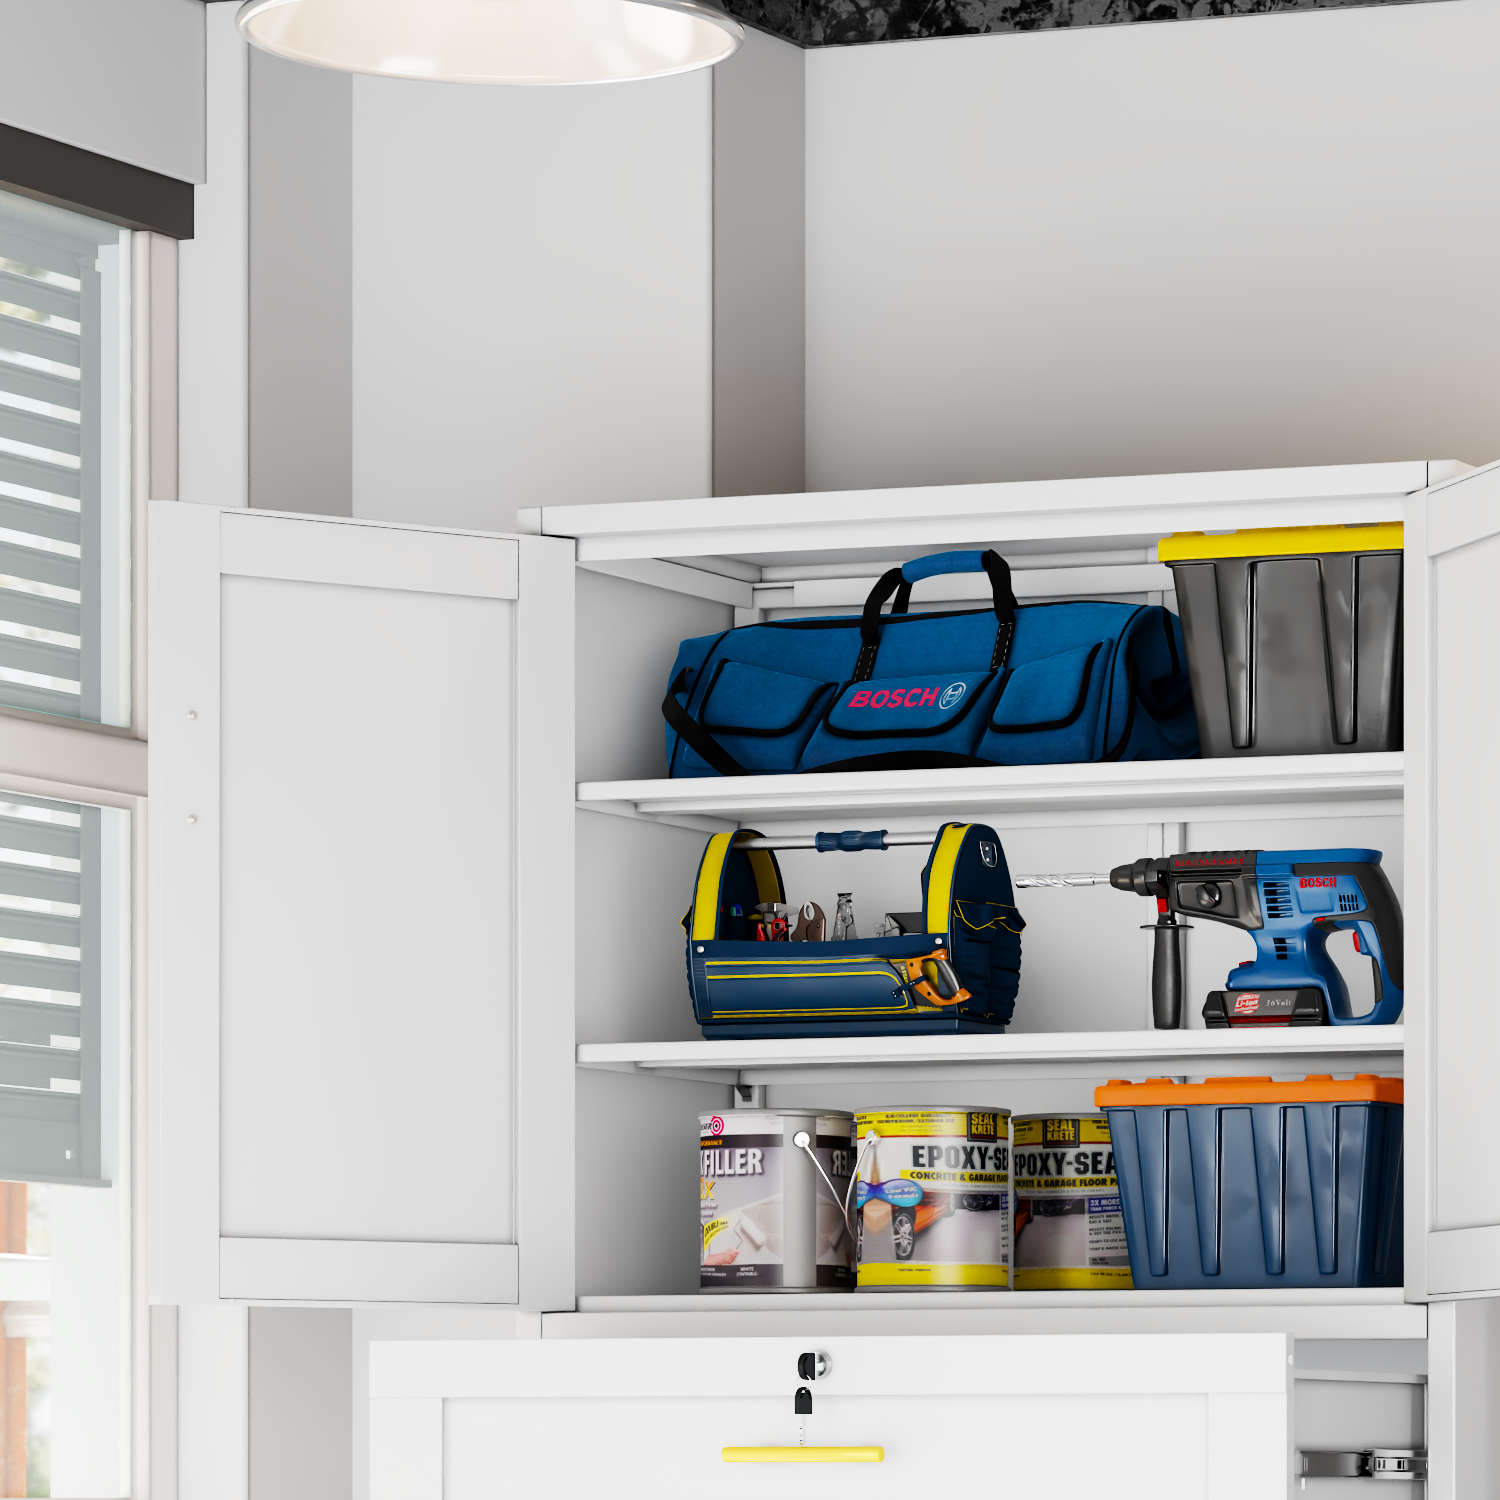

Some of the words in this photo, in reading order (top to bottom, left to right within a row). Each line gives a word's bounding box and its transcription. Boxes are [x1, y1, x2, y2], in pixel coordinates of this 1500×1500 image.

[847, 687, 940, 709] BOSCH
[1299, 876, 1337, 889] BOSCH
[1235, 999, 1259, 1008] Li-Ion
[971, 1112, 995, 1125] SEAL
[971, 1125, 995, 1135] KRETE
[1046, 1119, 1075, 1131] SEAL
[1046, 1130, 1075, 1141] KRETE
[912, 1145, 1009, 1171] EPOXY-SE
[910, 1171, 957, 1181] CONCRETE
[960, 1173, 966, 1182] &
[969, 1173, 996, 1183] GARAGE
[1036, 1179, 1042, 1188] &
[1044, 1179, 1077, 1188] GARAGE
[1079, 1178, 1108, 1187] FLOOR
